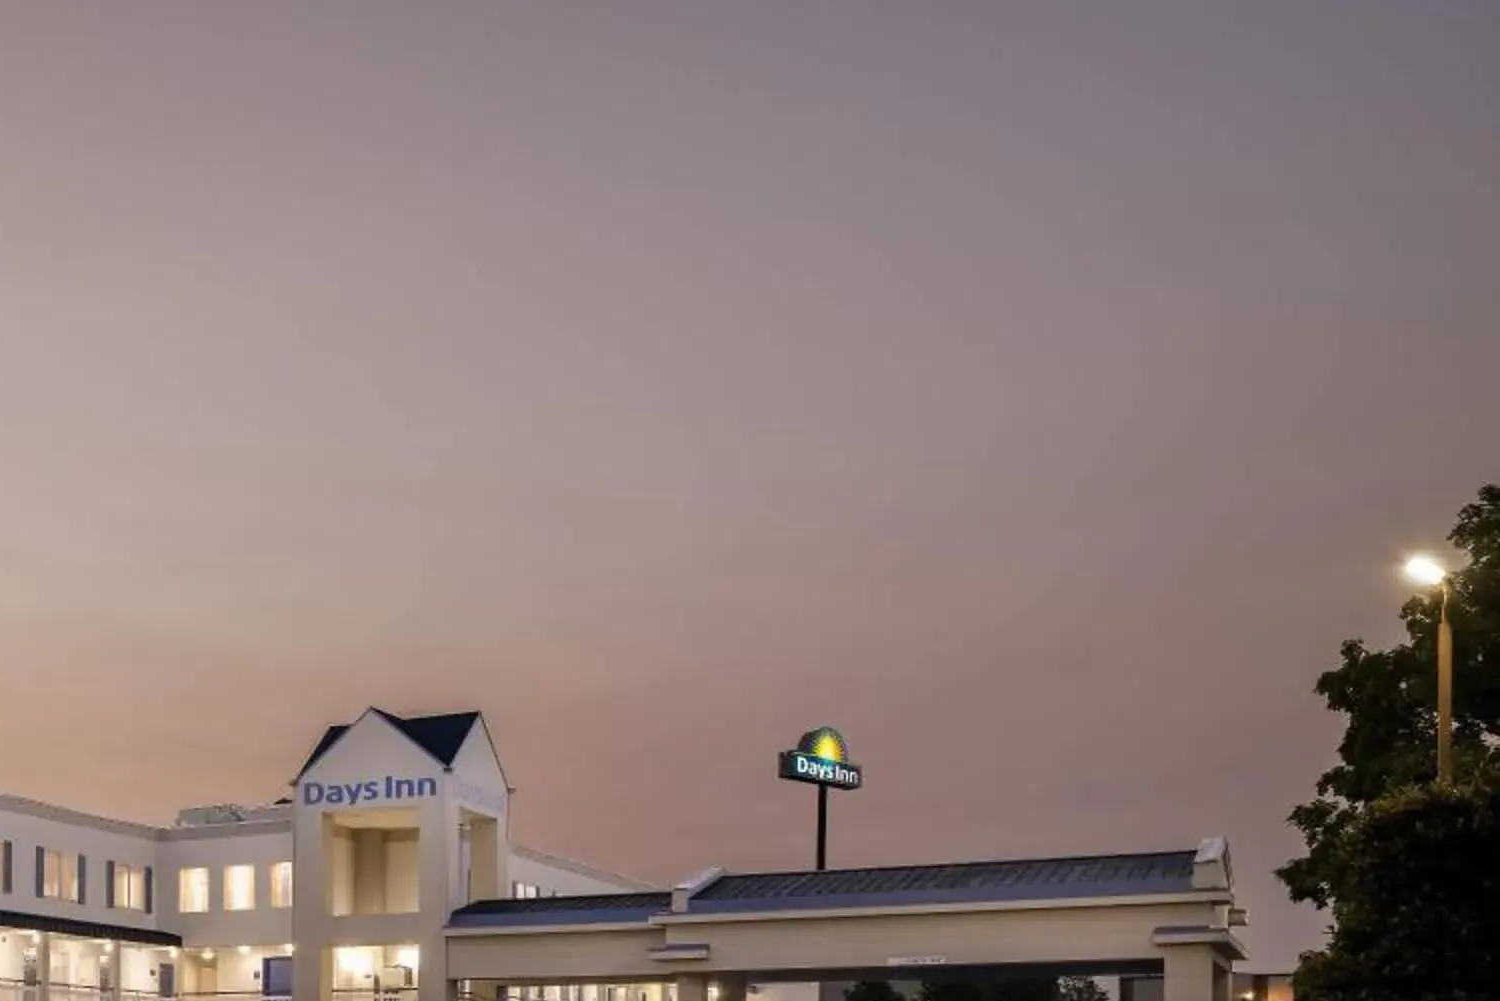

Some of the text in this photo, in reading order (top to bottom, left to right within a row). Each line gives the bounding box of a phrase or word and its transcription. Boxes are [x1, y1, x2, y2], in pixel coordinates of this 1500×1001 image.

[797, 756, 859, 784] Days Inn
[303, 775, 437, 806] Days Inn
